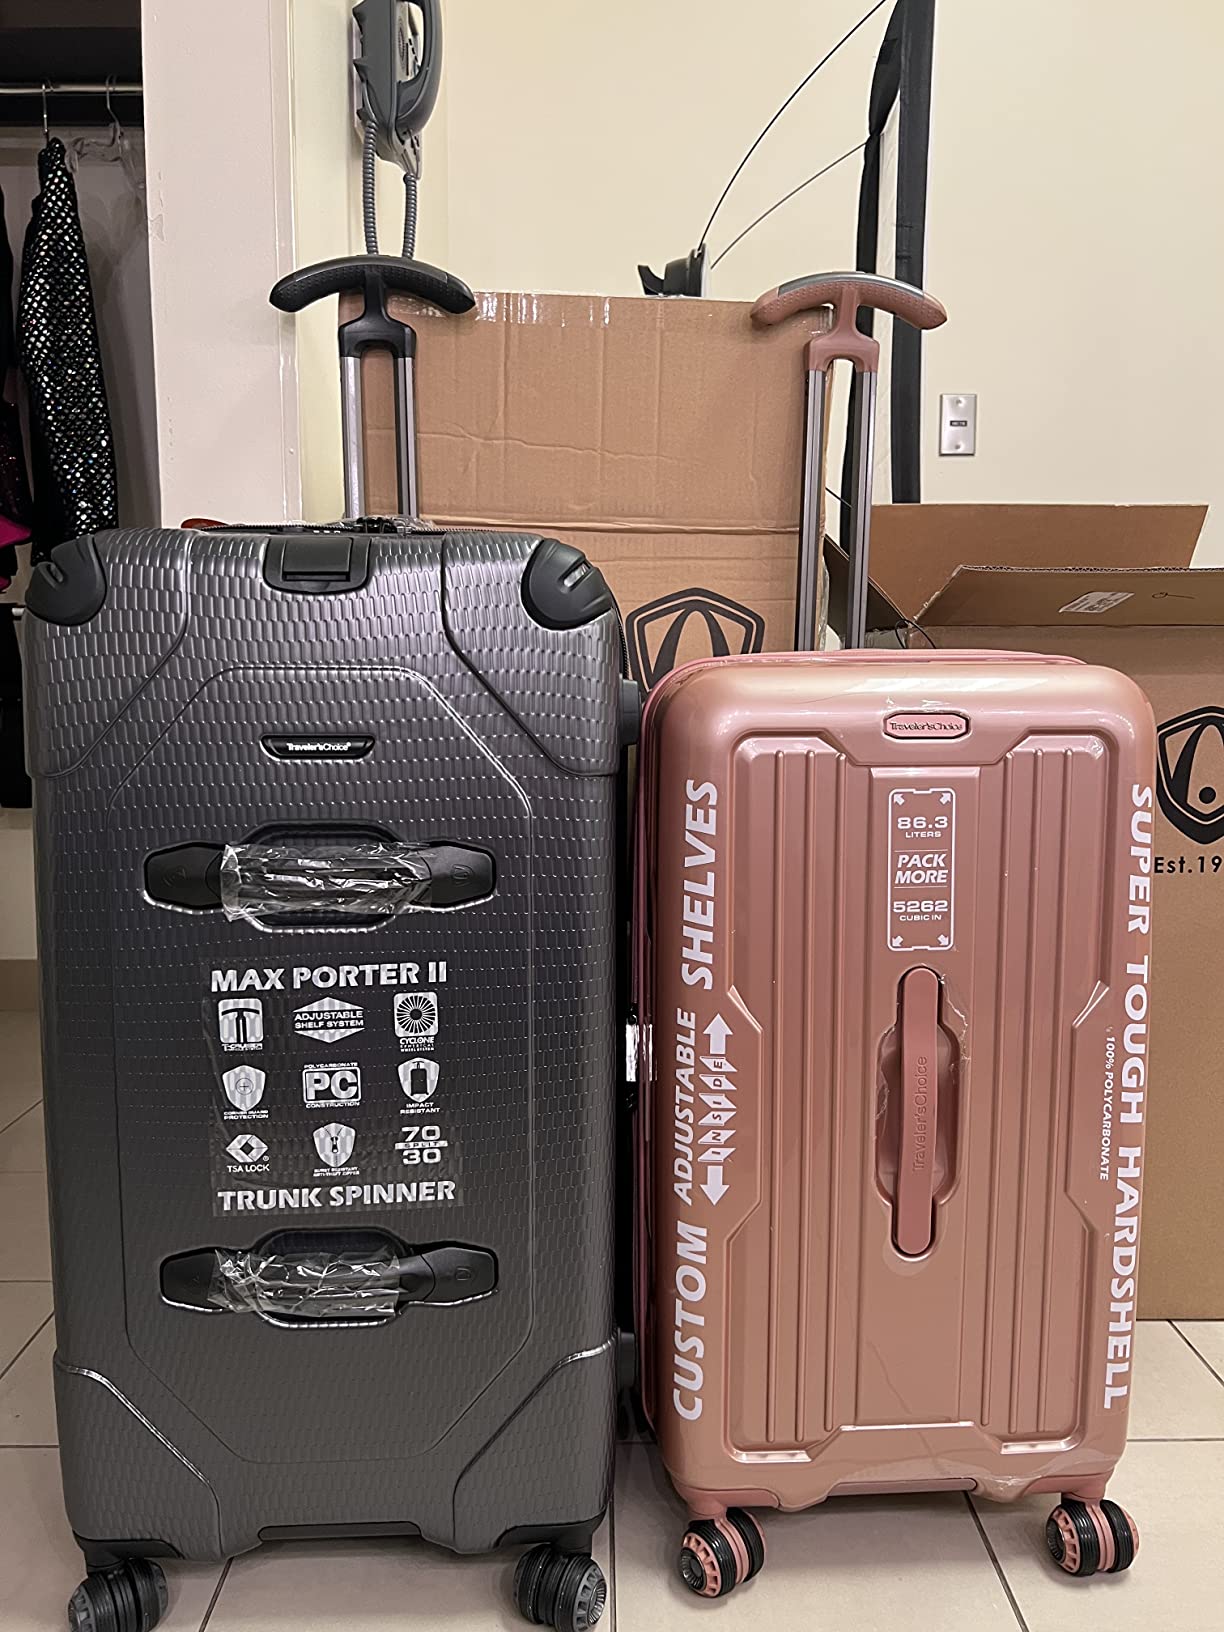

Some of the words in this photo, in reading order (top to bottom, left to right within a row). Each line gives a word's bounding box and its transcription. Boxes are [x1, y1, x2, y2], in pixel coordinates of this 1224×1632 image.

[897, 816, 948, 829] 86.3
[897, 853, 947, 868] PACK
[1127, 784, 1152, 935] SUPER
[681, 779, 718, 990] SHELVES
[895, 869, 948, 884] MORE
[893, 900, 948, 913] 5262
[931, 913, 942, 921] IN
[211, 968, 285, 992] MAX
[293, 962, 420, 989] PORTER
[428, 961, 447, 983] II
[294, 1010, 363, 1021] ADJUSTABLE
[294, 1020, 325, 1029] SHELF
[326, 1019, 364, 1028] SYSTEM
[400, 1036, 434, 1045] CYCLONE
[1105, 1036, 1116, 1070] 100%
[1120, 955, 1148, 1123] TOUGH
[306, 1070, 358, 1100] PC
[673, 1007, 696, 1206] ADJUSTABLE
[711, 1060, 723, 1155] INSIDE
[913, 1056, 928, 1172] Traveler'sChoice
[401, 1125, 441, 1142] 70
[1100, 1071, 1114, 1181] POLYCARBONATE
[226, 1165, 244, 1173] TSA
[245, 1163, 270, 1172] LOCK
[402, 1148, 441, 1165] 30
[217, 1187, 322, 1211] TRUNK
[329, 1180, 456, 1207] SPINNER
[1104, 1146, 1142, 1410] HARDSHELL
[673, 1221, 708, 1421] CUSTOM
